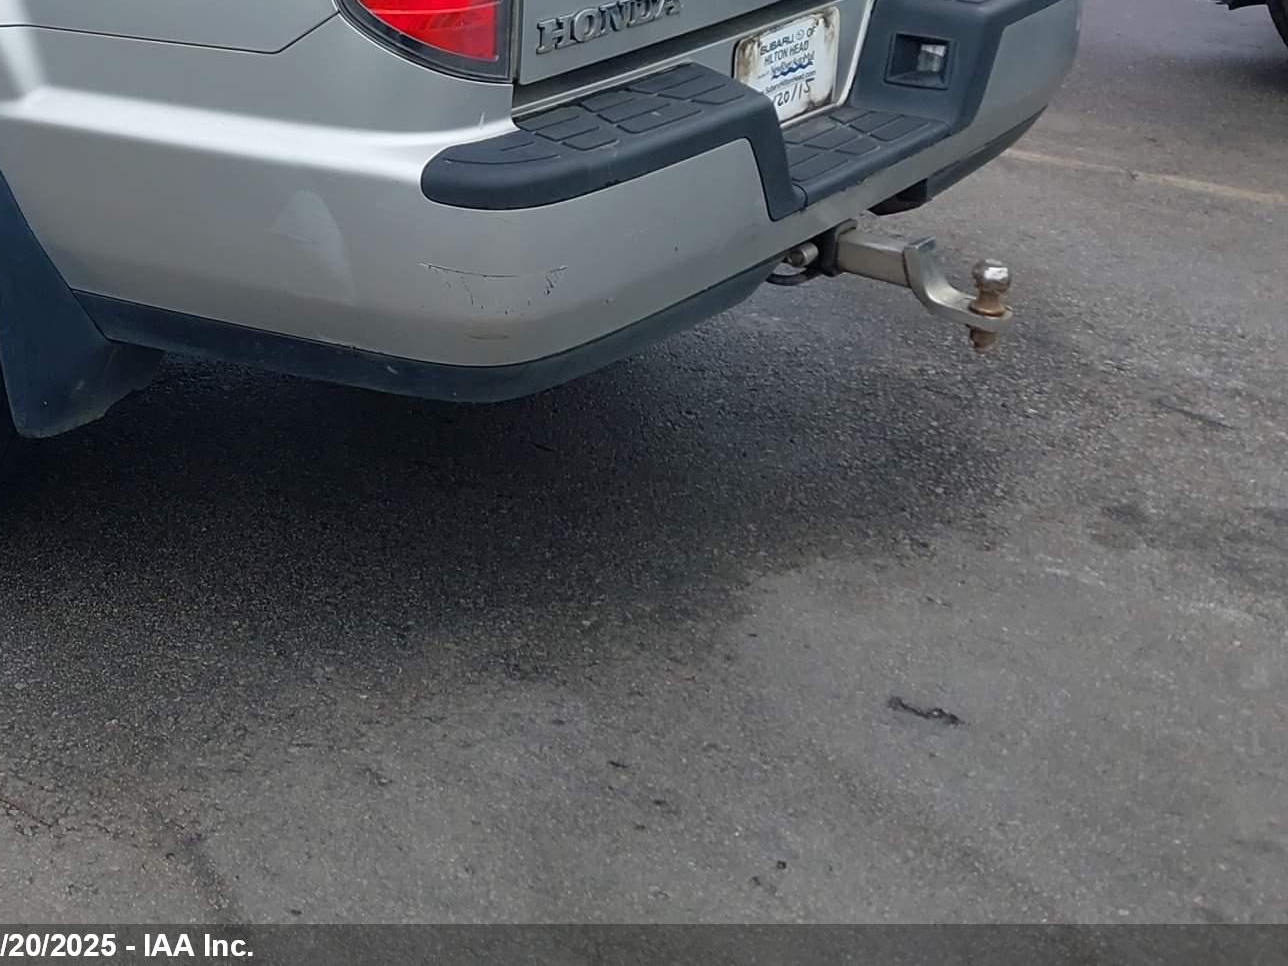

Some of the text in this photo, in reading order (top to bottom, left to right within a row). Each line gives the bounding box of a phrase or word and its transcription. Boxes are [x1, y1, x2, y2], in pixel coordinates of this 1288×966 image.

[759, 26, 817, 56] SUBARU OF
[764, 40, 810, 66] HILTON HEAD
